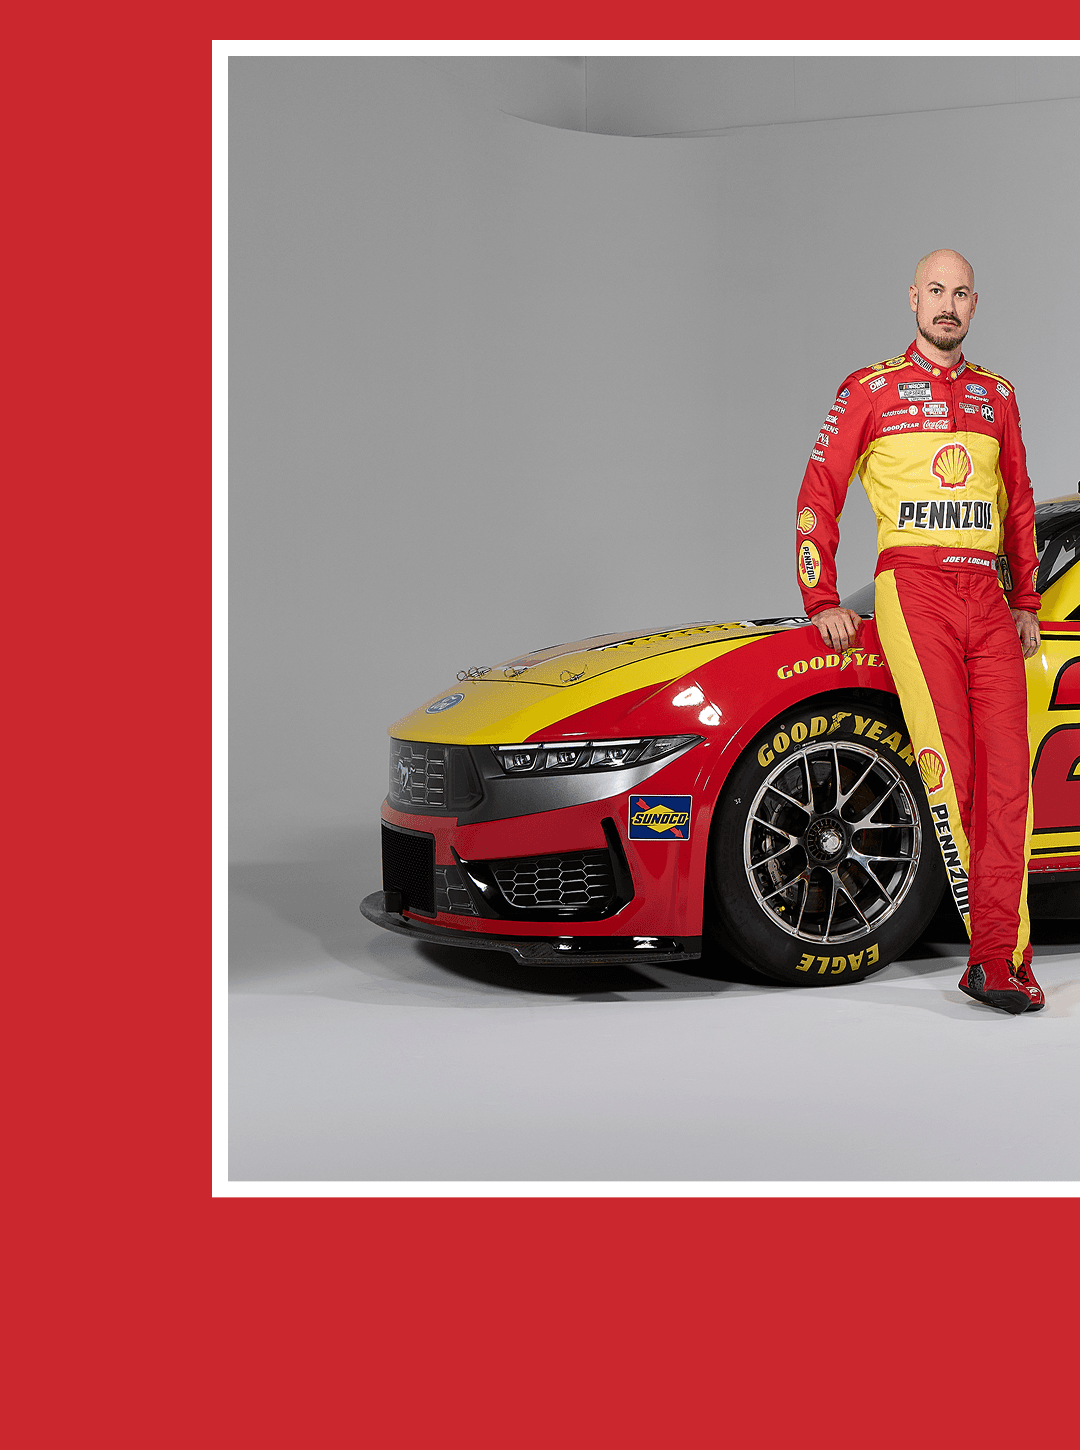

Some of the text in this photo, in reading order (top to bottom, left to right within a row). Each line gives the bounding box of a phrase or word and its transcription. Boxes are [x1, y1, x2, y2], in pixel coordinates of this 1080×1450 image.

[869, 377, 886, 390] OMP
[883, 422, 919, 432] GOODYEAR
[923, 419, 948, 430] Coca-Cola
[898, 501, 993, 530] PENNZOIL
[802, 546, 816, 581] PENNZOIL
[967, 557, 990, 567] LOGANO
[632, 811, 688, 827] SUNOCO
[796, 943, 880, 975] EAGLE
